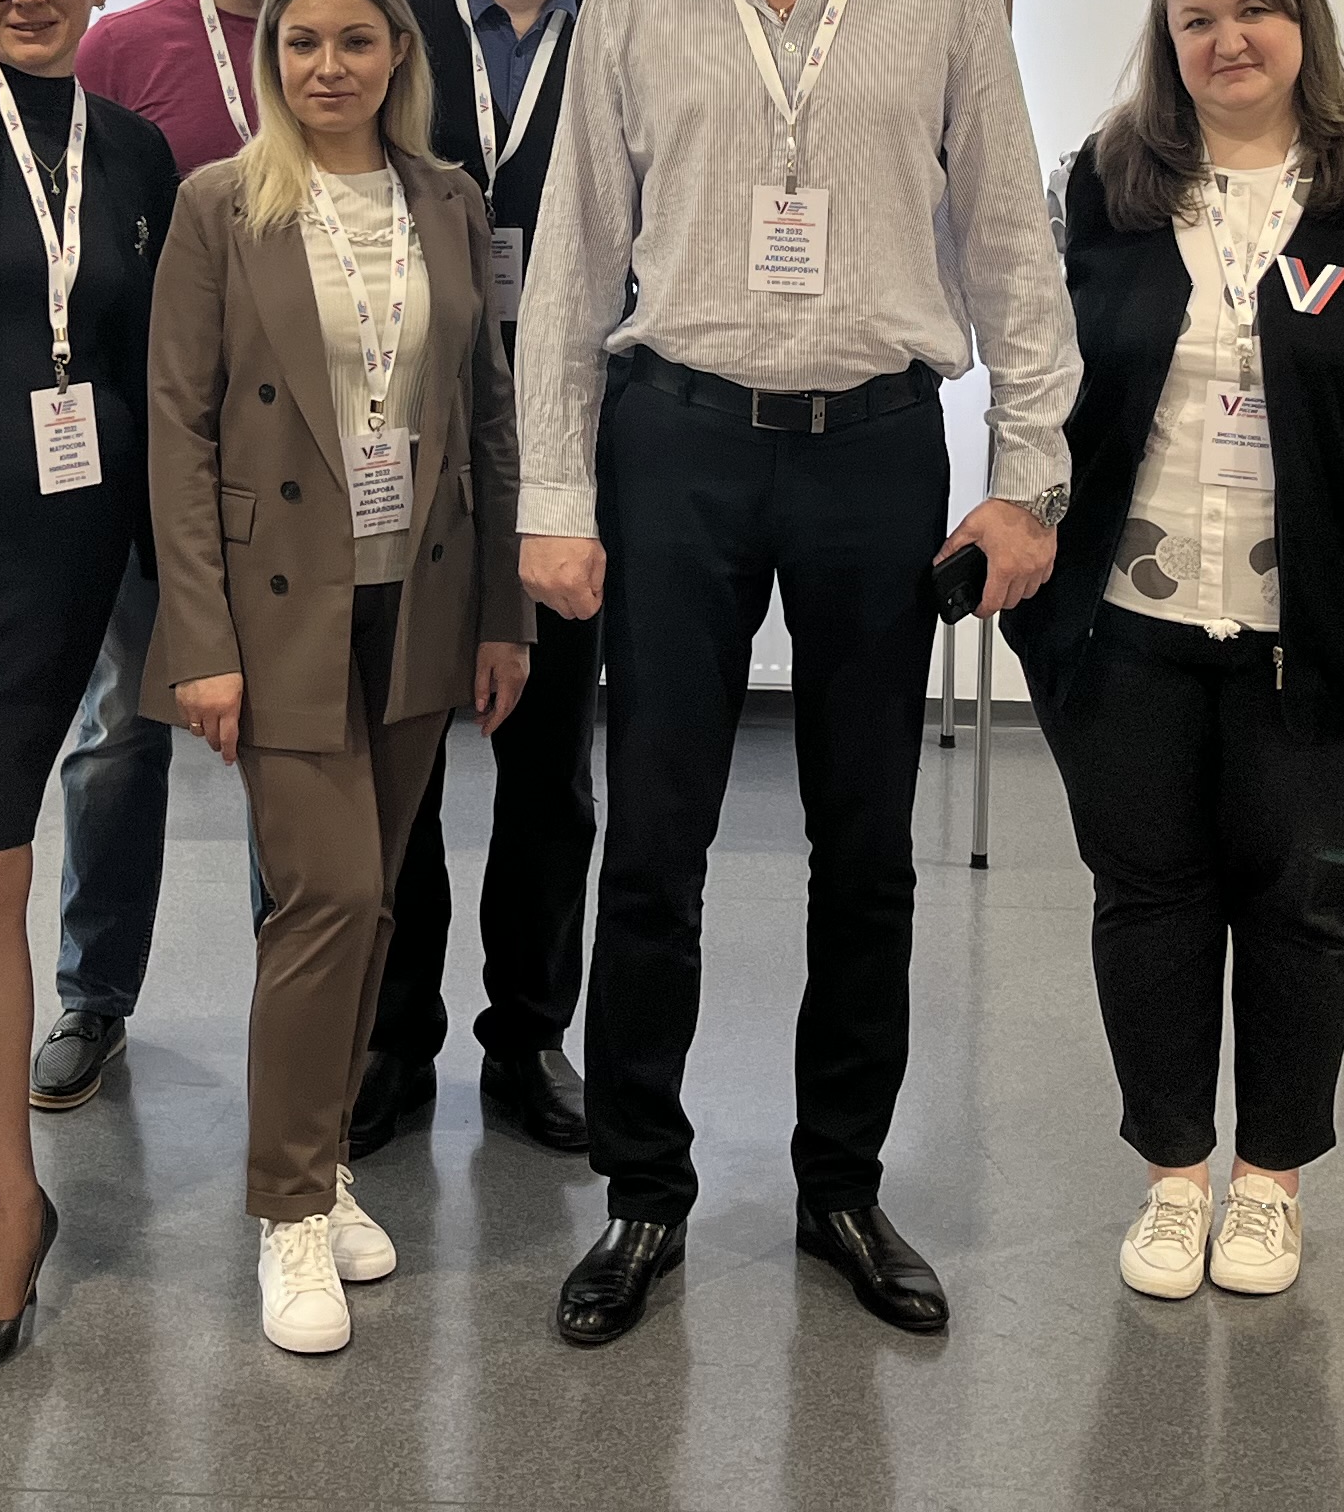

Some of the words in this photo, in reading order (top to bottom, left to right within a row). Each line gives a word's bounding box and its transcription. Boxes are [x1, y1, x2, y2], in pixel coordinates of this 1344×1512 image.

[767, 235, 810, 243] ПРЕДСЕДАТЕЛЬ
[770, 245, 806, 253] ГОЛОВИН
[765, 255, 810, 263] АЛЕКСАНДР
[755, 264, 819, 274] ВЛАДИМИРОВИЧ
[363, 485, 395, 496] УВАРОВА
[360, 494, 400, 506] АНАСТАСИЯ
[356, 503, 404, 516] МИХАЙЛОВНА
